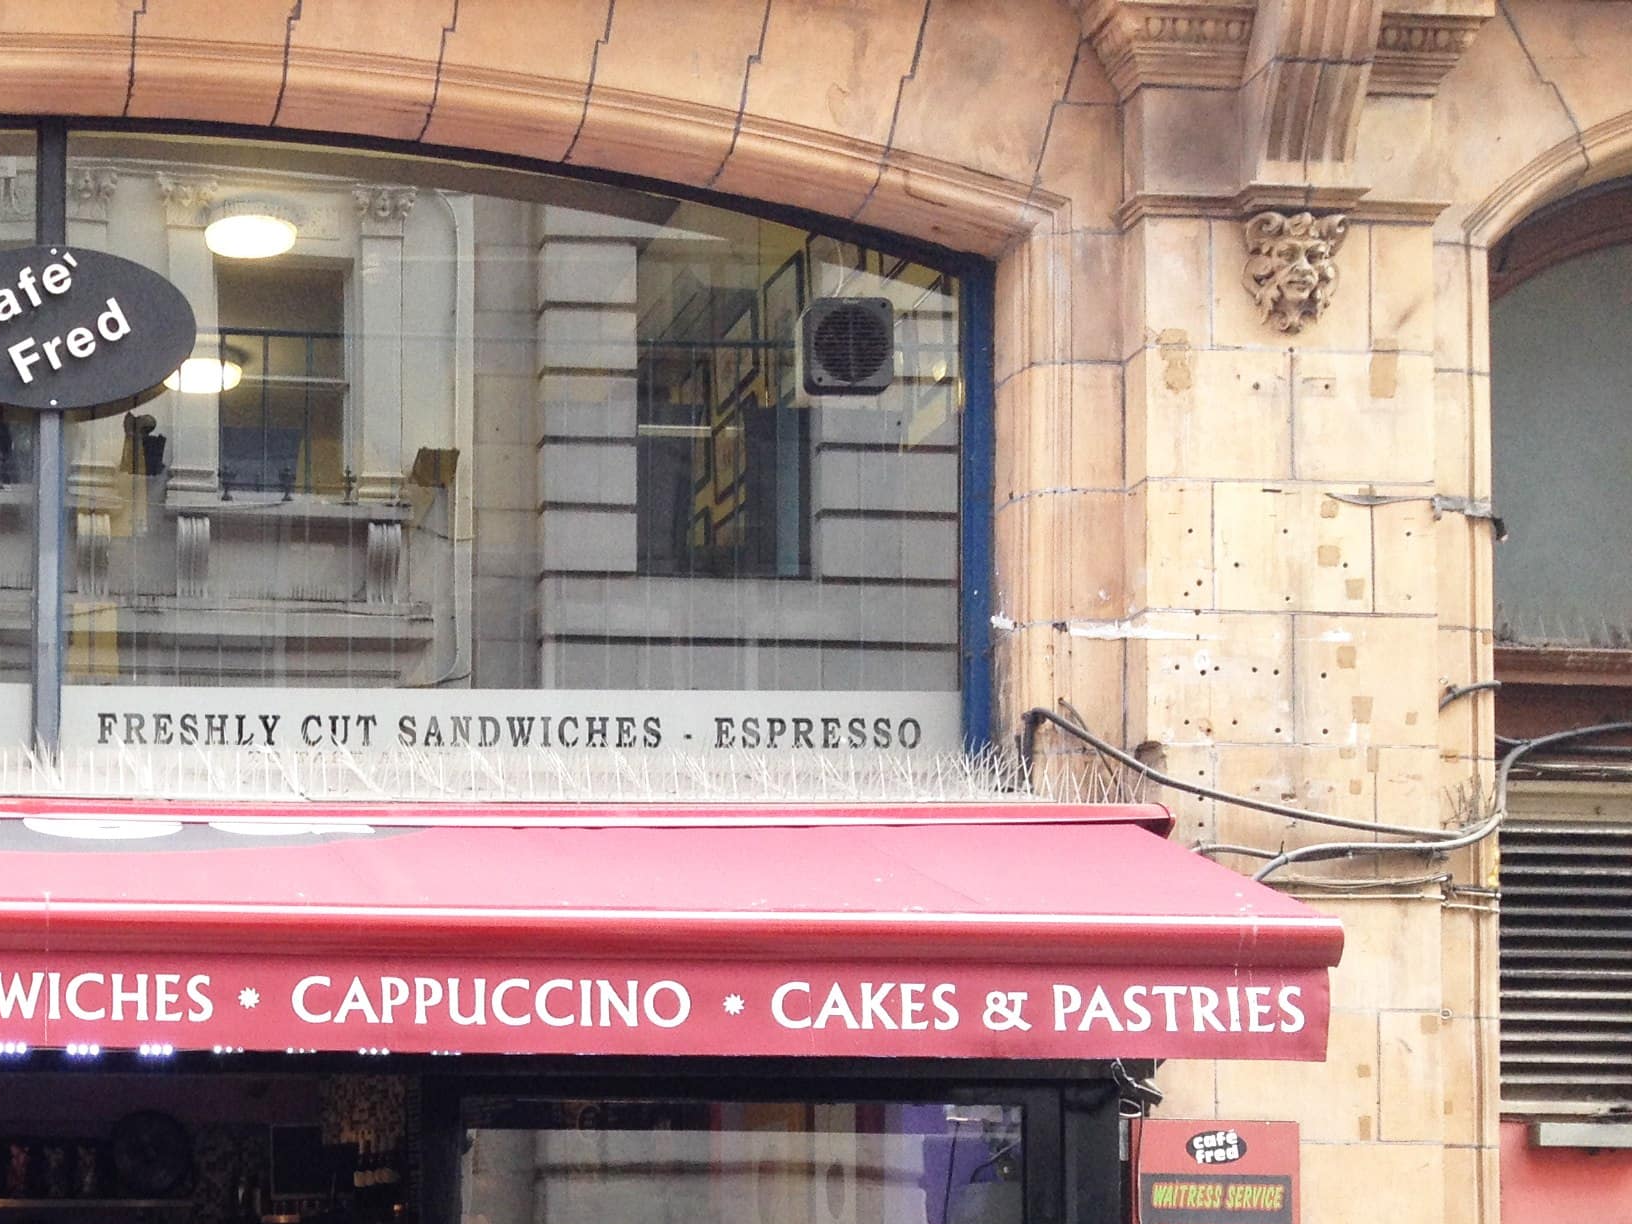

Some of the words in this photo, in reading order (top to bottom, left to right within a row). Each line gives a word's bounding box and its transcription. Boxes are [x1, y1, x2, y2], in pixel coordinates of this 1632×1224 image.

[8, 297, 131, 383] Fred
[98, 712, 280, 745] FRESHLY
[301, 714, 377, 746] CUT
[399, 715, 662, 748] SANDWICHES
[714, 717, 922, 749] ESPRESSO
[291, 975, 691, 1028] CAPPUCCINO
[771, 981, 959, 1031] CAKES
[982, 991, 1031, 1031] &
[1053, 984, 1305, 1033] PASTRIES
[1195, 1145, 1239, 1164] fred
[1153, 1183, 1221, 1207] WAITRESS
[1226, 1184, 1284, 1209] SERVICE
